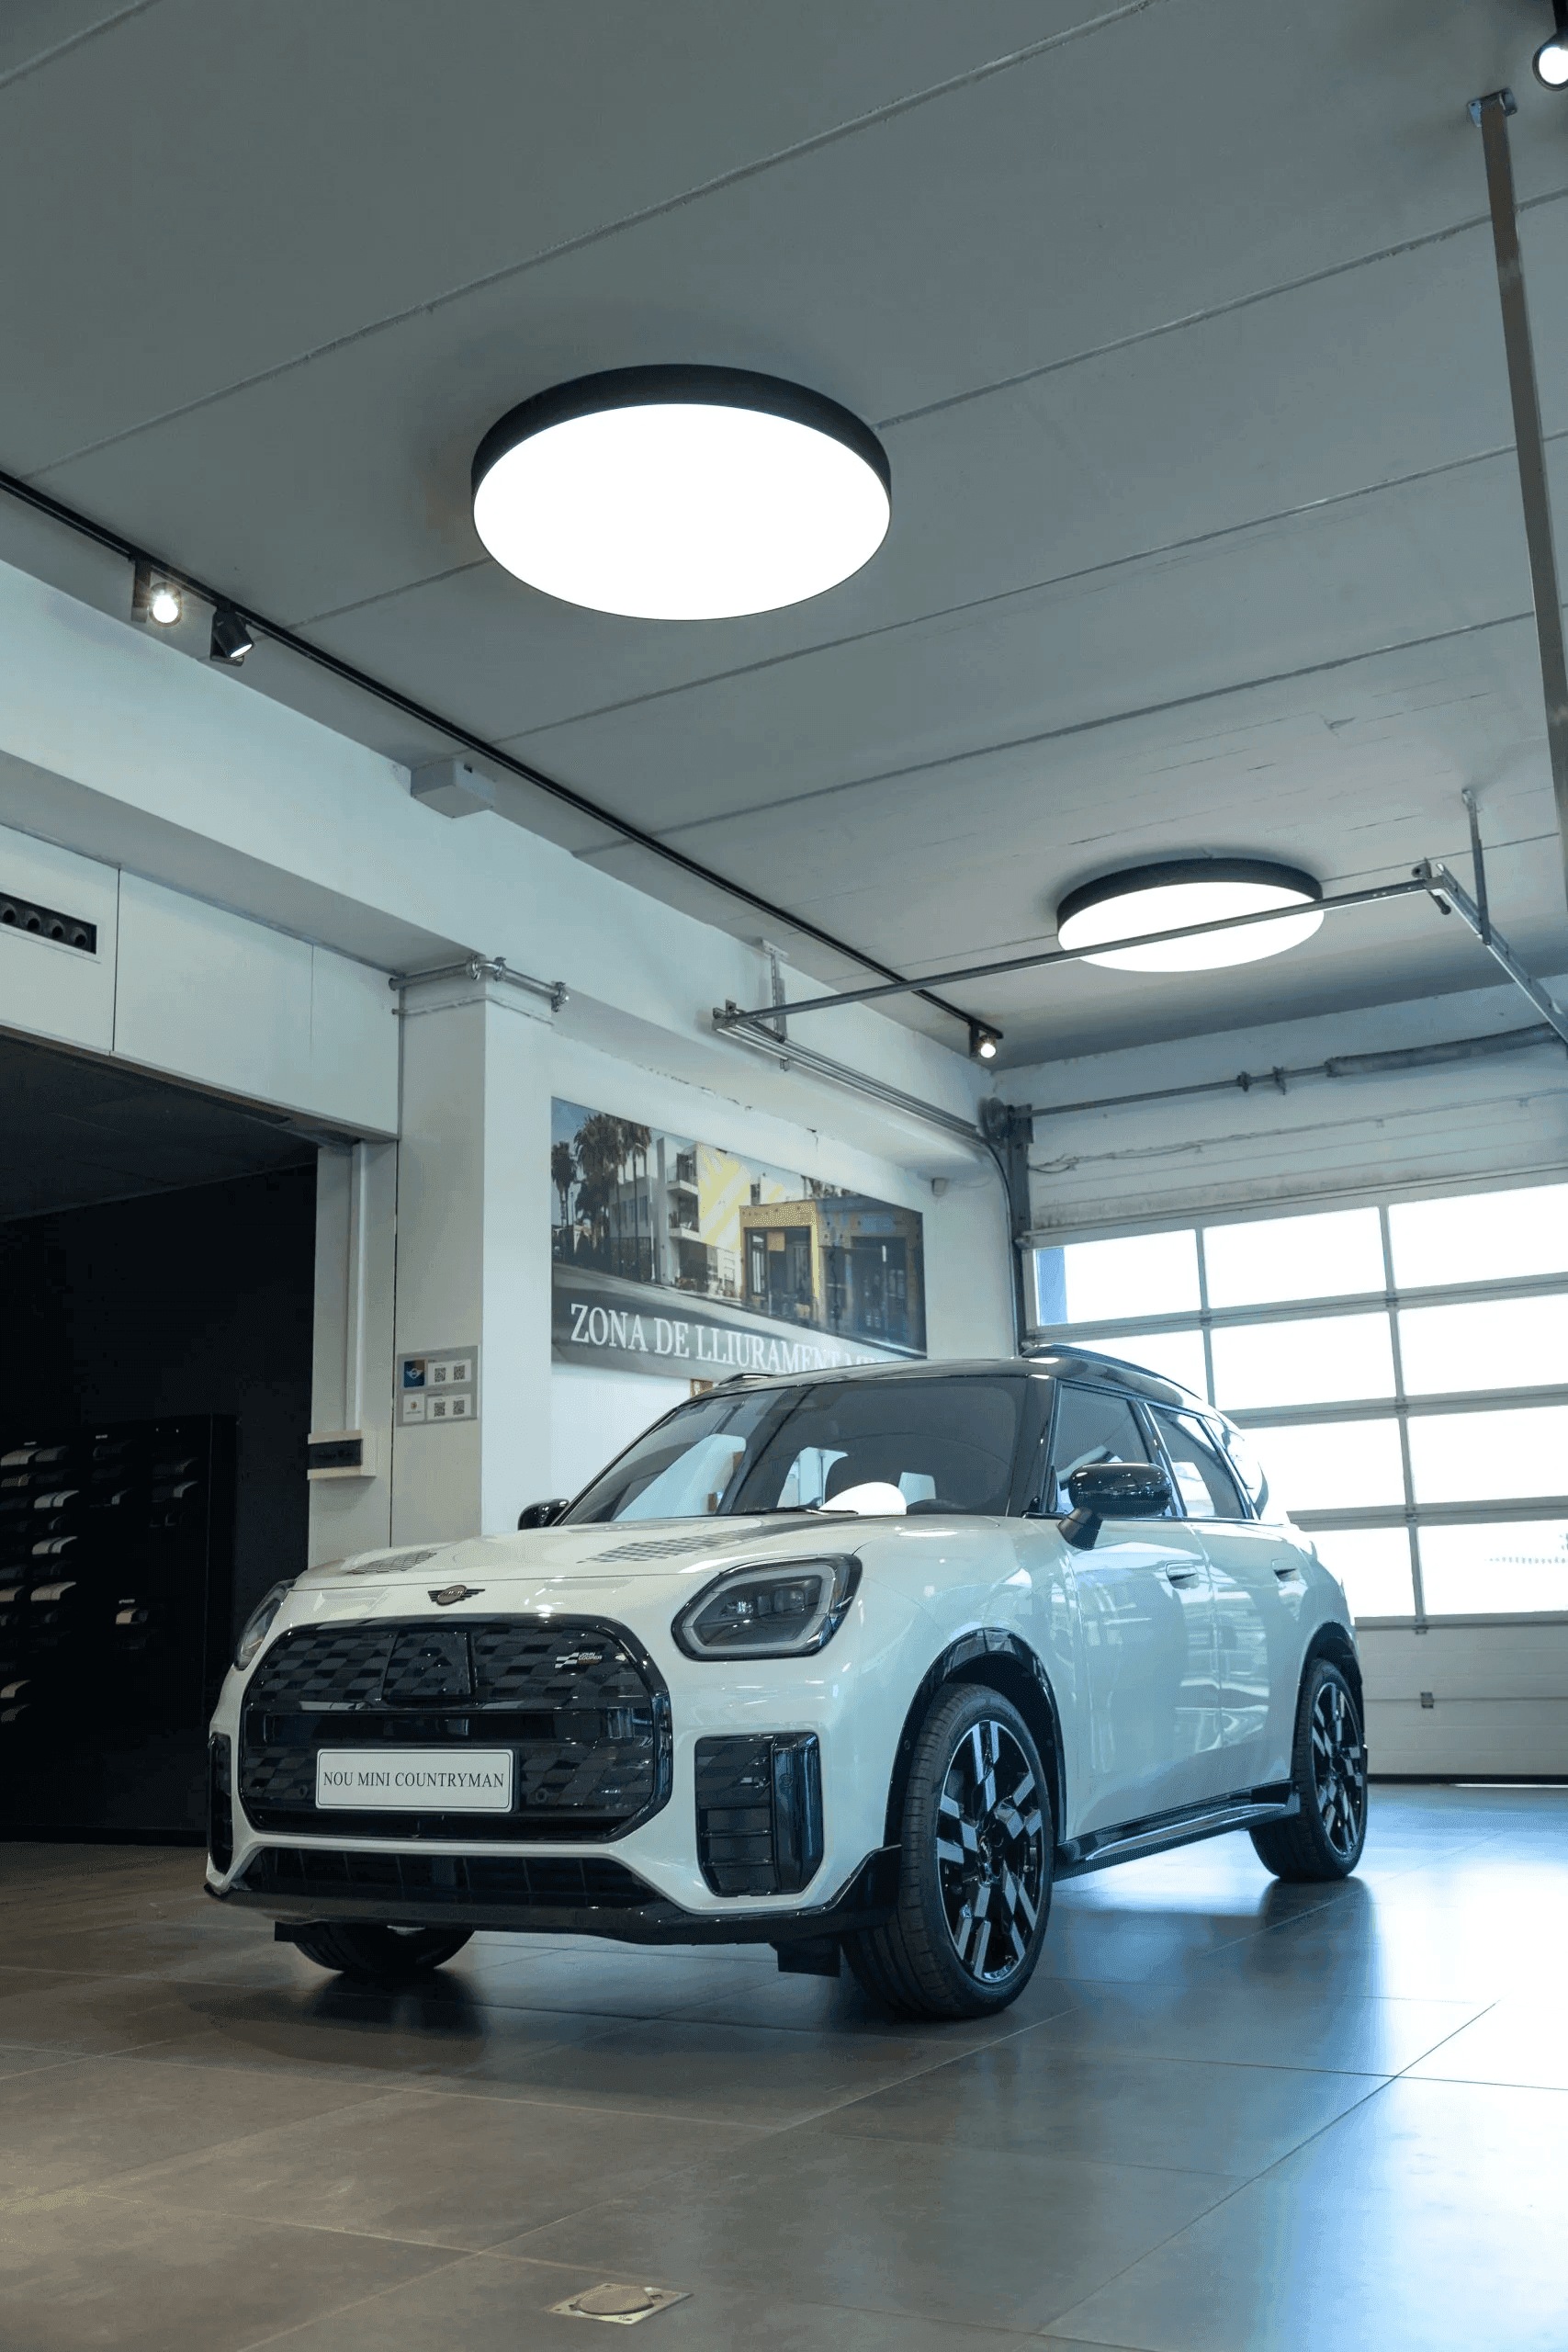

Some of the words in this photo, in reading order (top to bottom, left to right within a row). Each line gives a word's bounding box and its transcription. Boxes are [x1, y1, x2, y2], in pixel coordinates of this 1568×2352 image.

[570, 1303, 649, 1352] ZONA
[653, 1317, 690, 1358] DE
[323, 1771, 354, 1786] NOU
[357, 1772, 390, 1786] MINI
[395, 1772, 504, 1788] COUNTRYMAN
